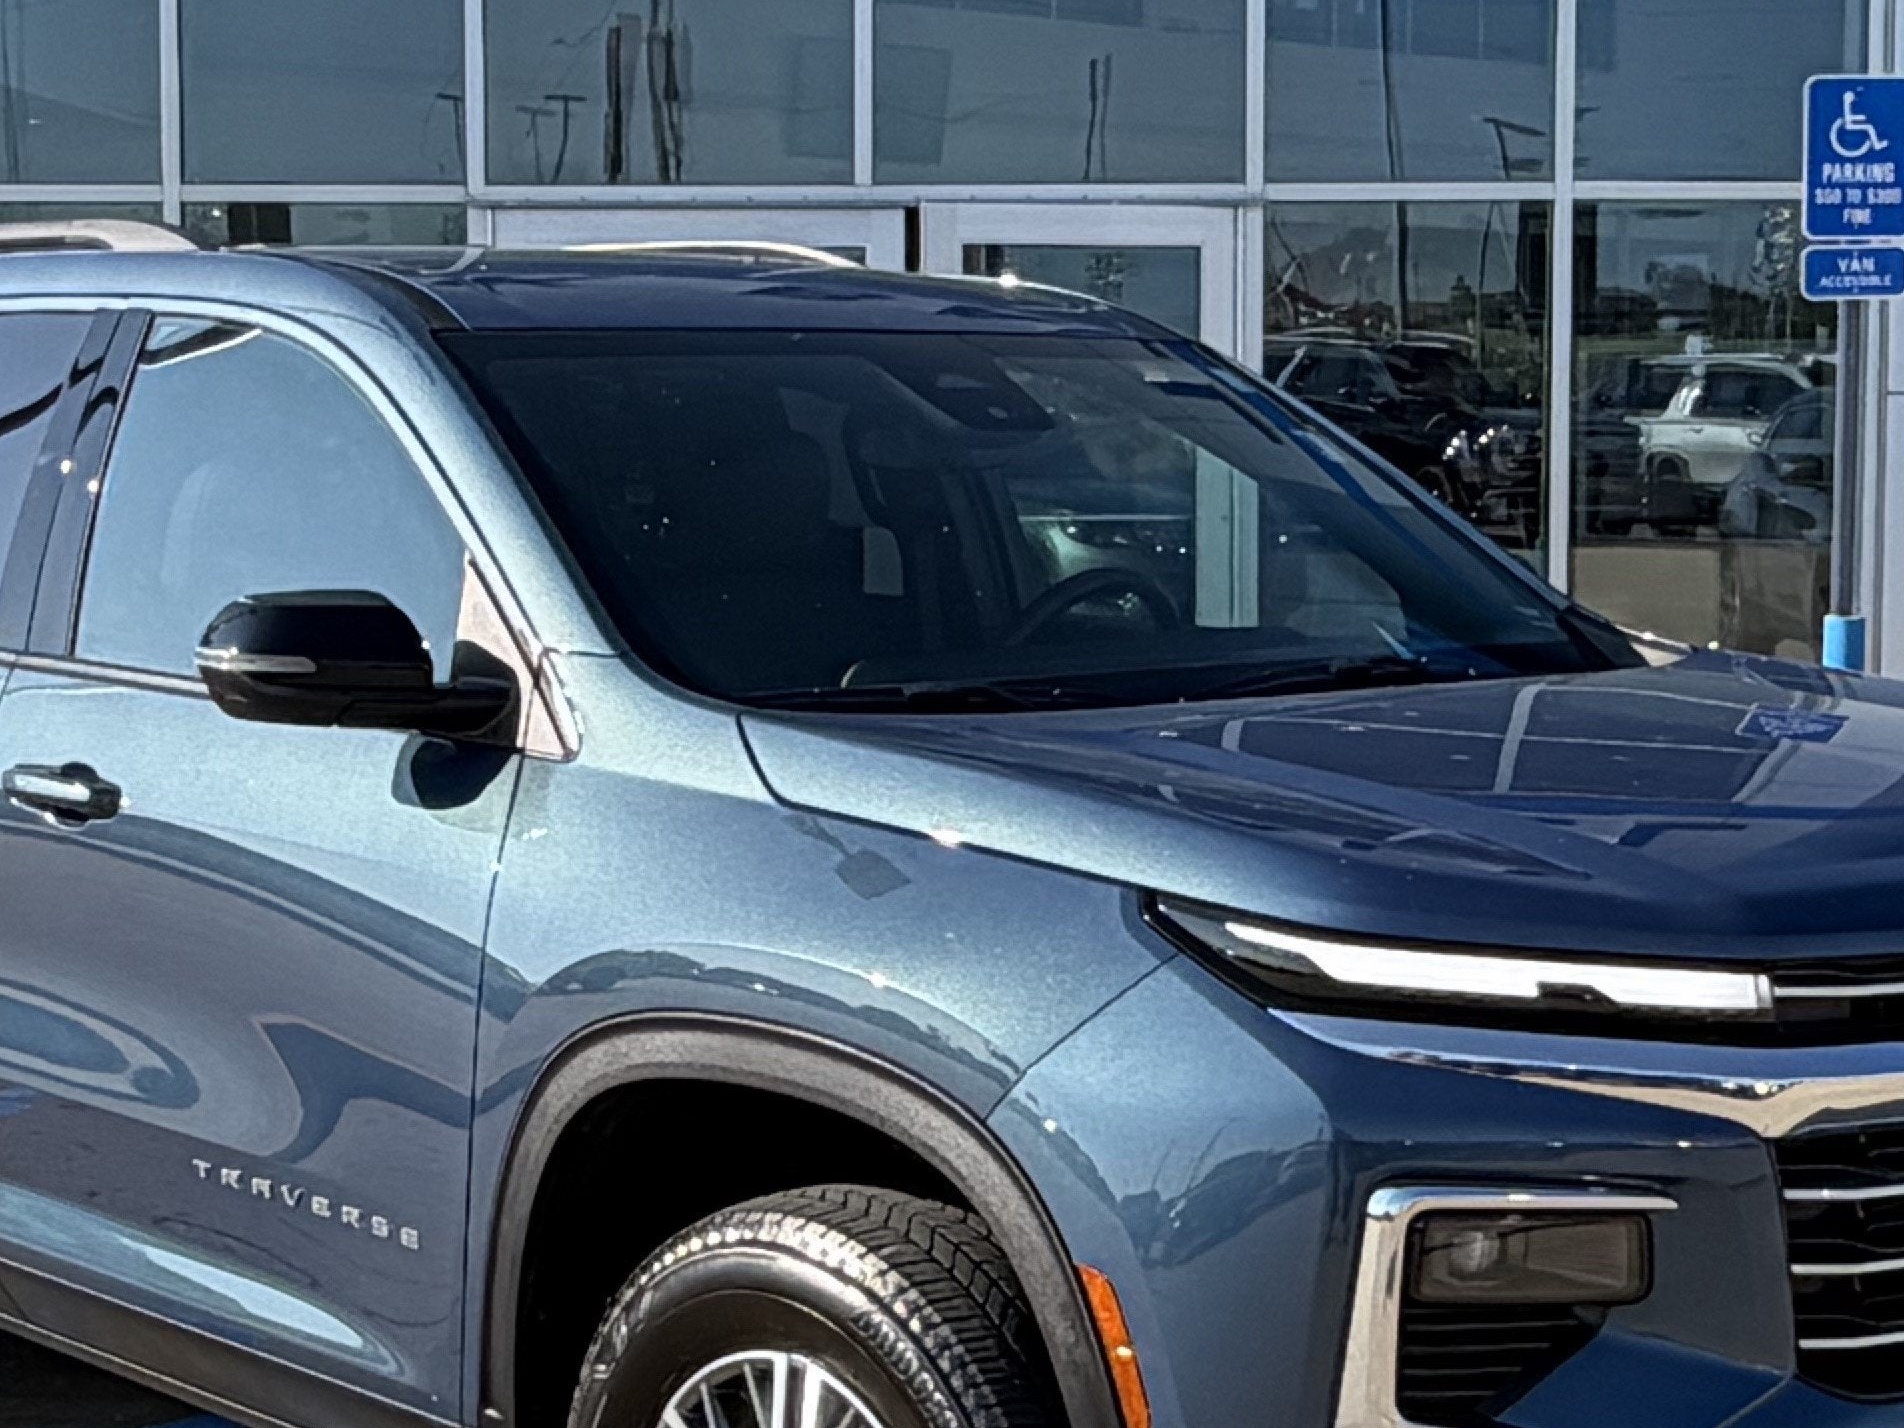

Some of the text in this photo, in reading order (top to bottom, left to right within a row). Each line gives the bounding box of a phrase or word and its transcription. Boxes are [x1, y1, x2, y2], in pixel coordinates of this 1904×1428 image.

[1822, 162, 1895, 184] PARKING
[1846, 187, 1862, 204] TO
[1837, 257, 1876, 272] VAN
[192, 1158, 419, 1251] TRAVERSE
